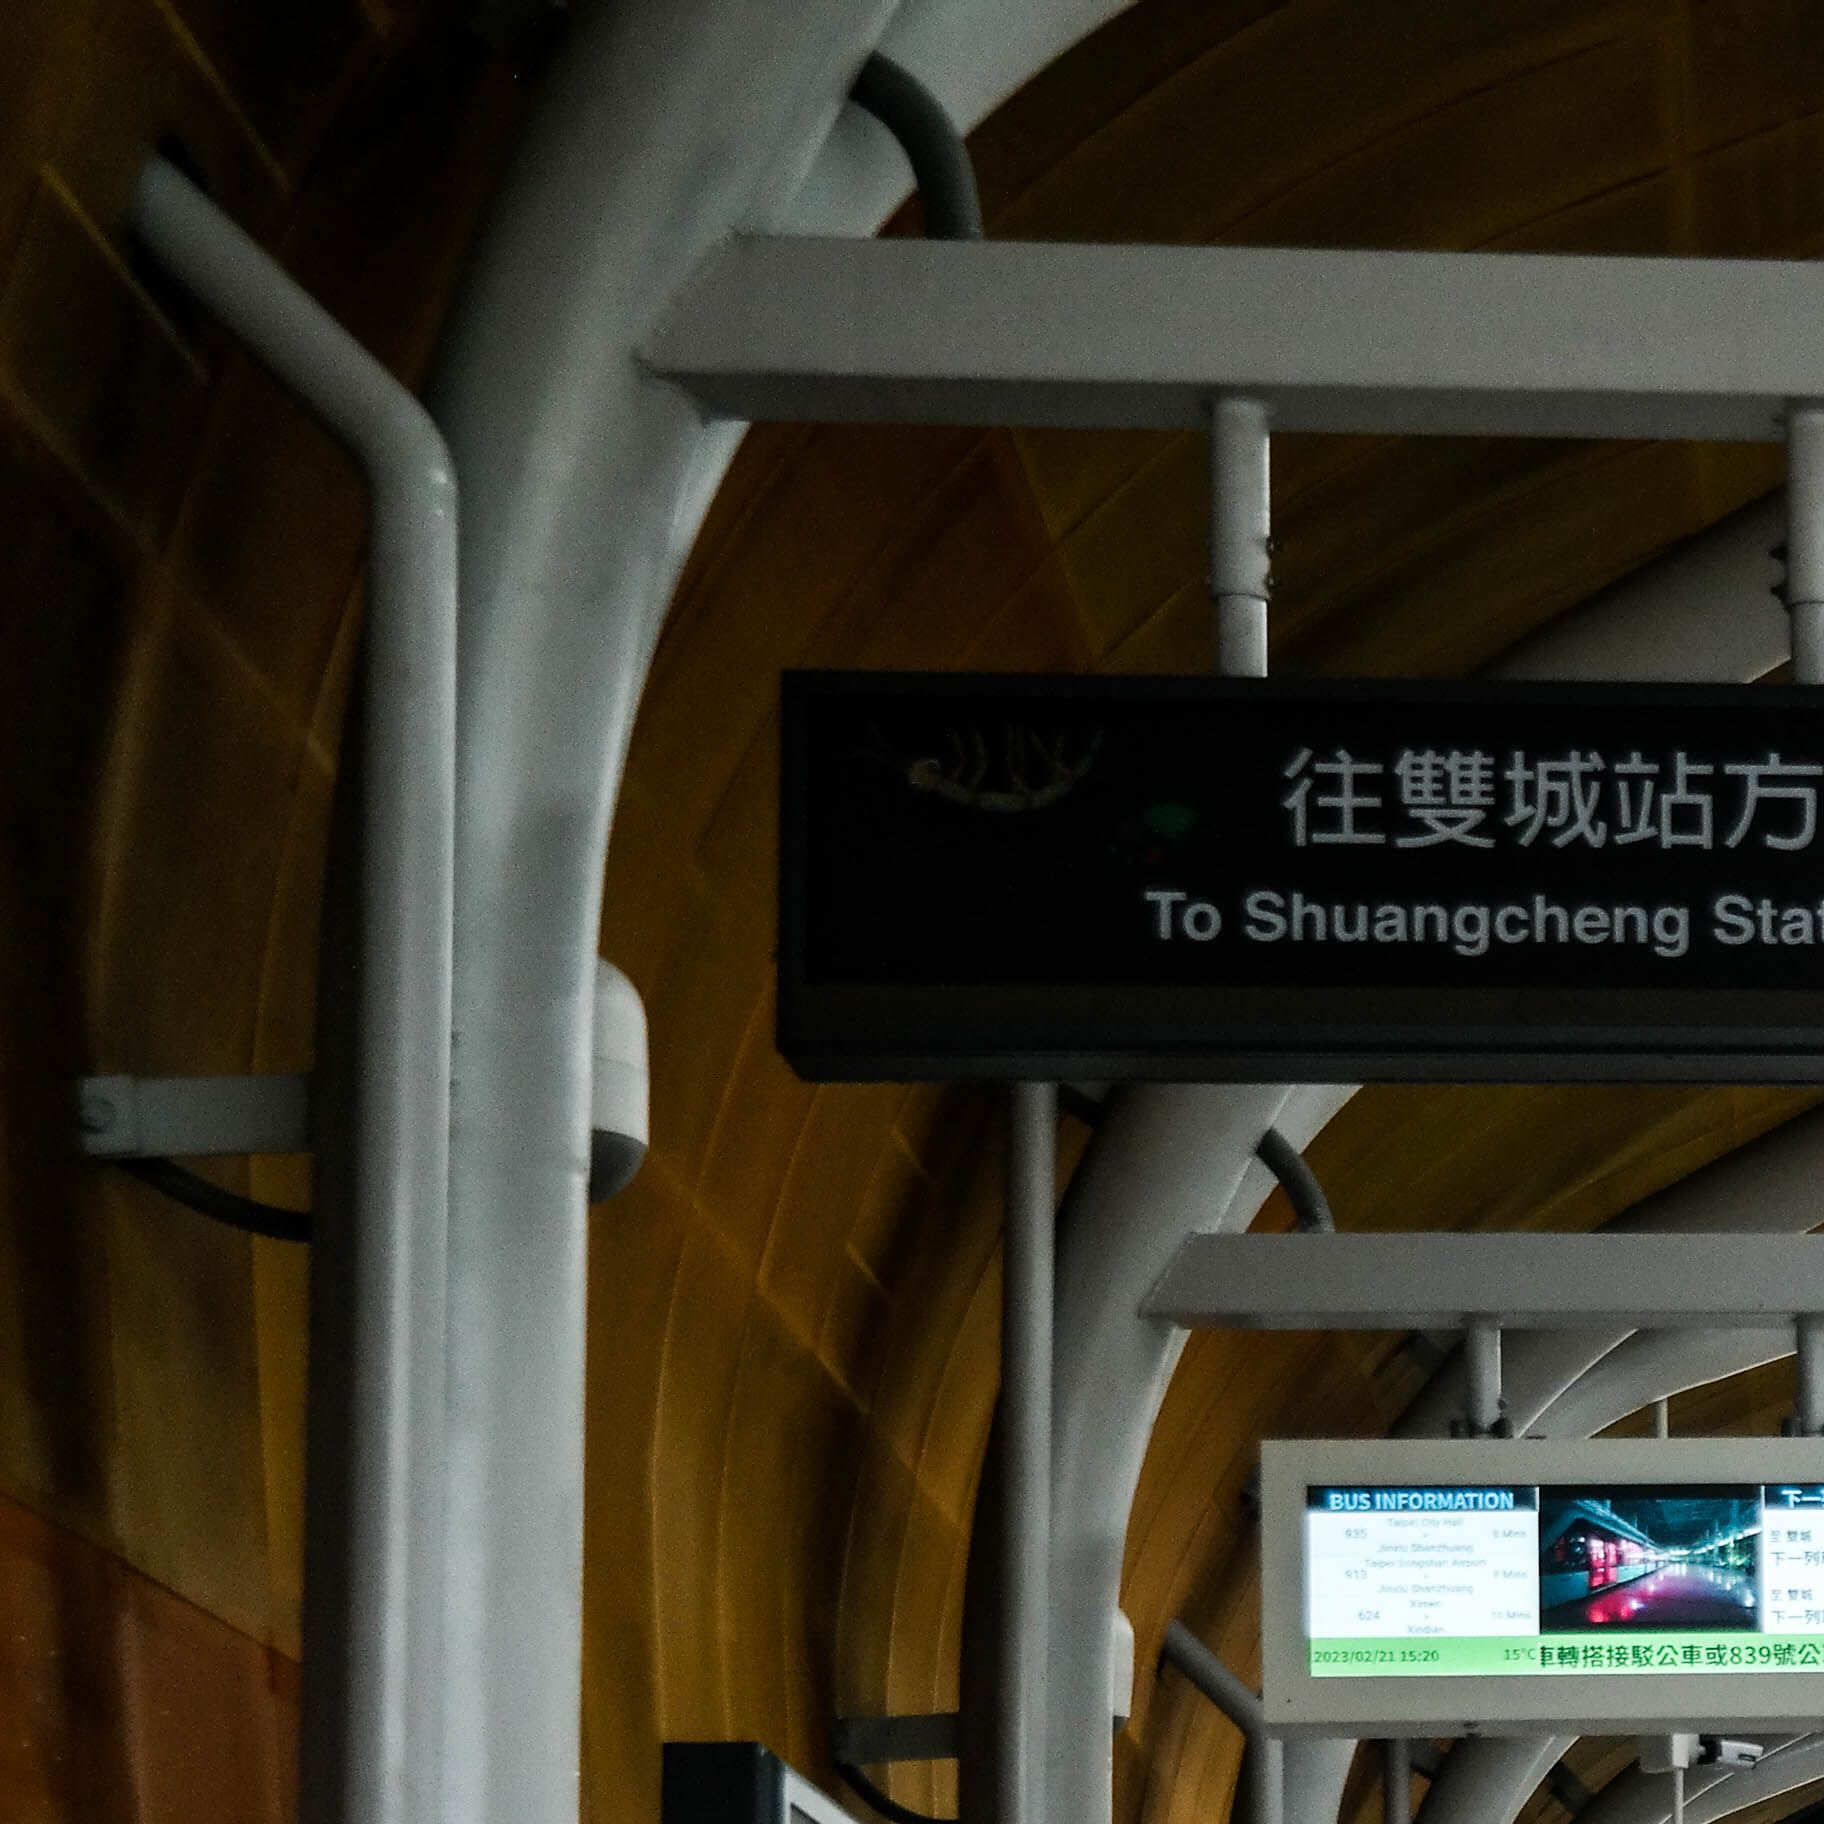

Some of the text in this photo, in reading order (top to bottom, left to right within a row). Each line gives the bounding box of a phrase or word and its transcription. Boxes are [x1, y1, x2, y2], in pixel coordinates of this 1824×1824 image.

[1147, 890, 1220, 941] To
[1244, 888, 1689, 957] Shuangcheng
[1328, 1492, 1515, 1511] BUS INFORMATION
[1358, 1609, 1381, 1621] 624
[1313, 1649, 1440, 1664] 2023/02/21 15:20
